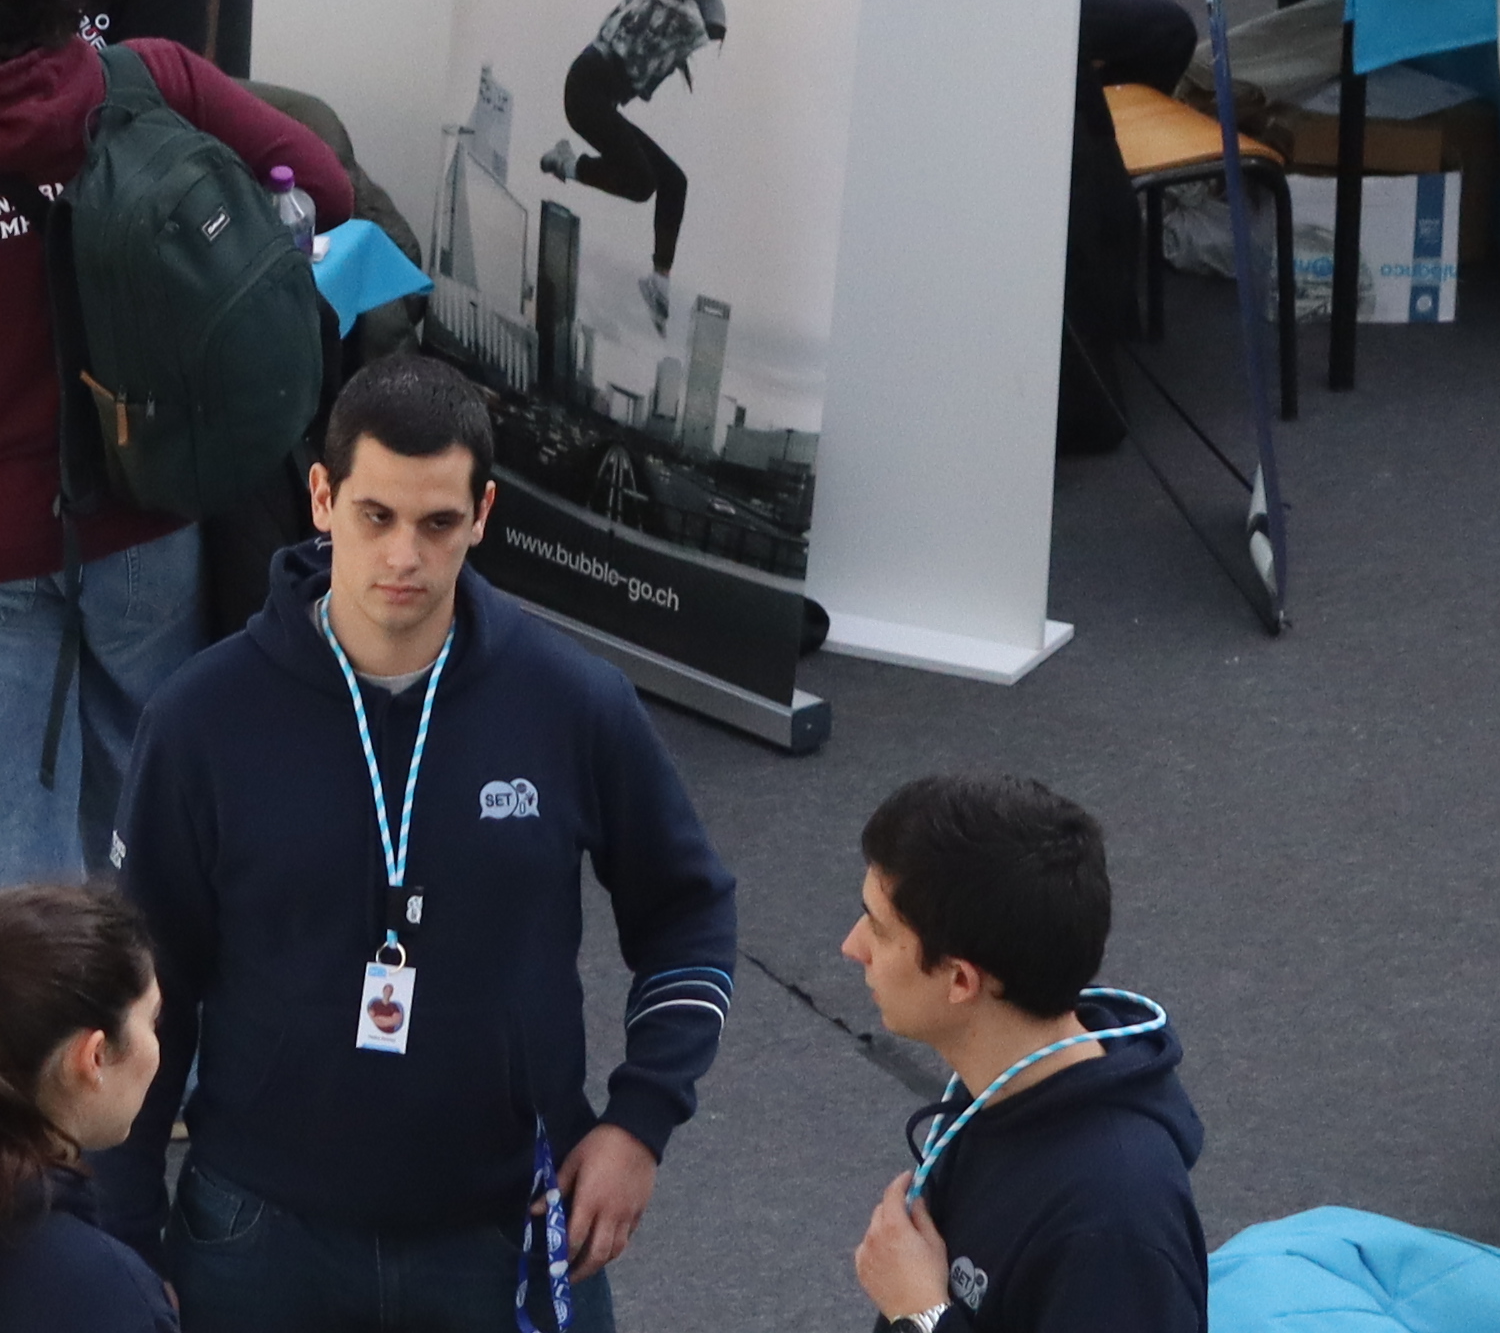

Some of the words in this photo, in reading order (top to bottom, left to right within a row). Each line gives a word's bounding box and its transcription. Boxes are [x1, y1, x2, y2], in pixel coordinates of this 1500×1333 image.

[505, 525, 681, 613] www.bubble-go.ch
[485, 792, 513, 808] SET
[952, 1265, 972, 1290] SET
